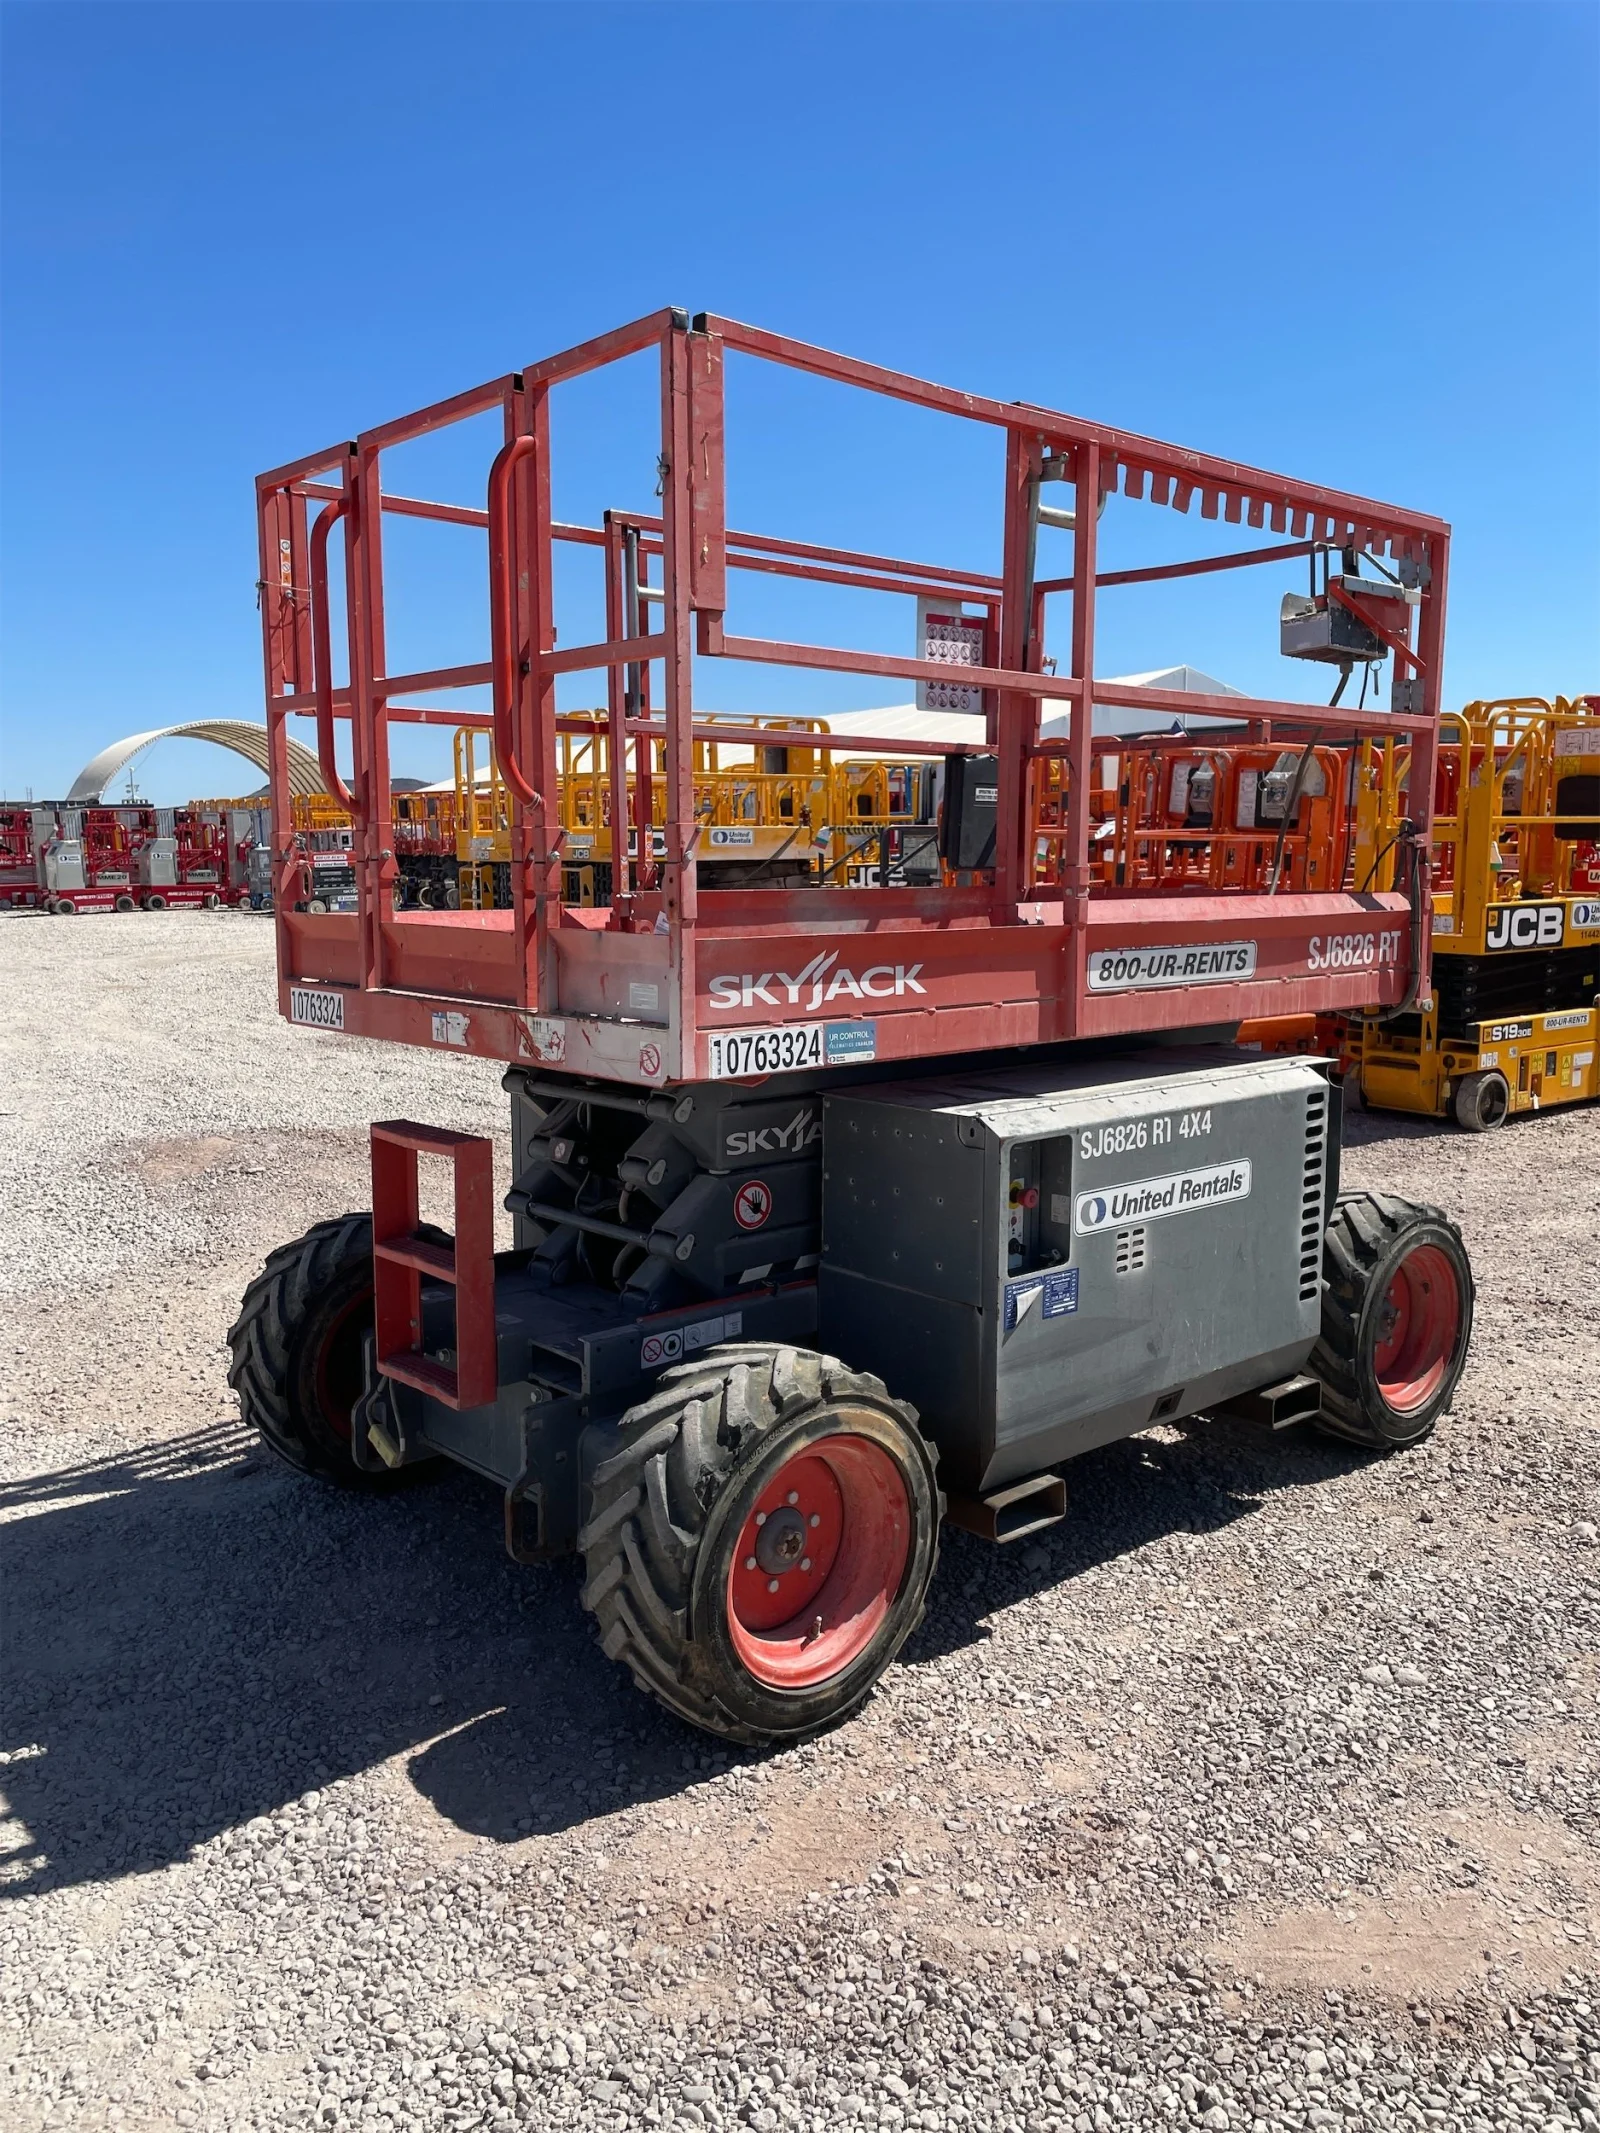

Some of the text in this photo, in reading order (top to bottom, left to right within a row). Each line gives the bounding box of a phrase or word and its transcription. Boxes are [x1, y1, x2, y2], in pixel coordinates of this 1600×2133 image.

[573, 850, 590, 859] JCB
[1487, 907, 1563, 949] JCB
[1098, 948, 1248, 981] 800-UR-RENTS
[1308, 931, 1401, 970] SJ6826 RT
[708, 949, 927, 1011] SKYJACK
[291, 990, 342, 1027] 10763324
[1546, 1014, 1588, 1028] 800-UR-RENTS
[713, 1029, 821, 1076] 10763324
[829, 1031, 869, 1041] UR CONTROL
[1080, 1121, 1148, 1160] SJ6826
[1179, 1110, 1212, 1139] 4X4
[1111, 1183, 1176, 1219] United
[1179, 1169, 1243, 1204] Rentals
